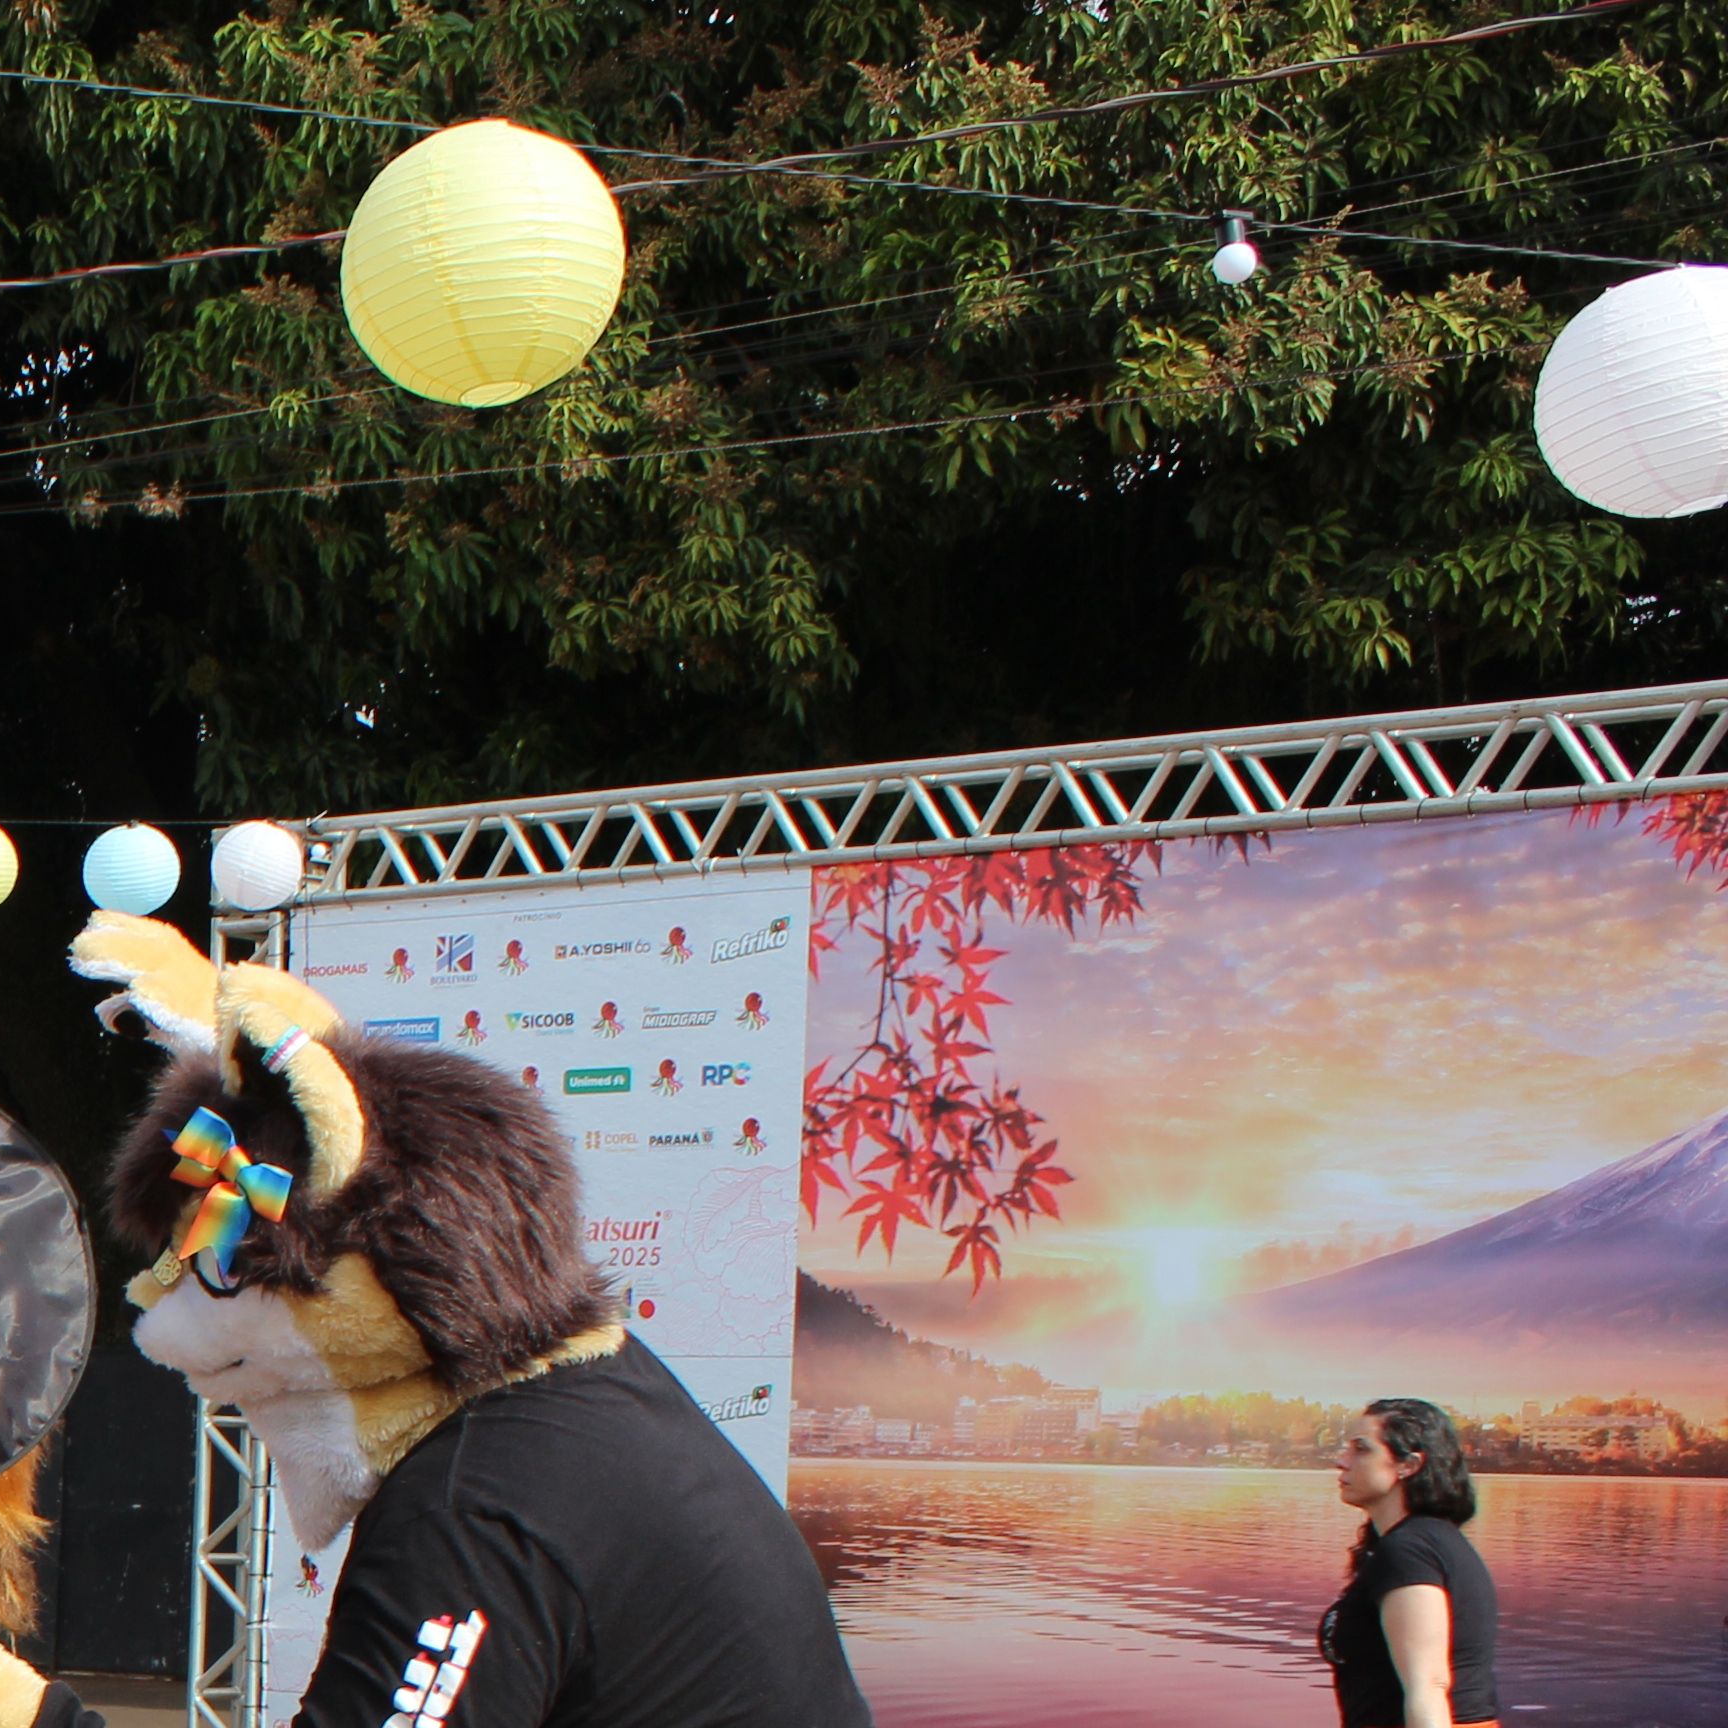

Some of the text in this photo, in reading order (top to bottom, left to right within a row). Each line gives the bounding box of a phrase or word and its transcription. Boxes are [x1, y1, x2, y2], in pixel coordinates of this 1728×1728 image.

[569, 941, 633, 957] A.YOSHII
[710, 929, 789, 964] Refriko
[303, 963, 368, 977] DROGAMAIS
[521, 1013, 575, 1028] SICOOB
[642, 1011, 716, 1029] MIDIOGRAF
[569, 1077, 611, 1087] Unimed
[701, 1062, 750, 1086] RPC
[605, 1133, 639, 1144] COPEL
[580, 1211, 660, 1241] atsuri
[608, 1247, 661, 1266] 2025
